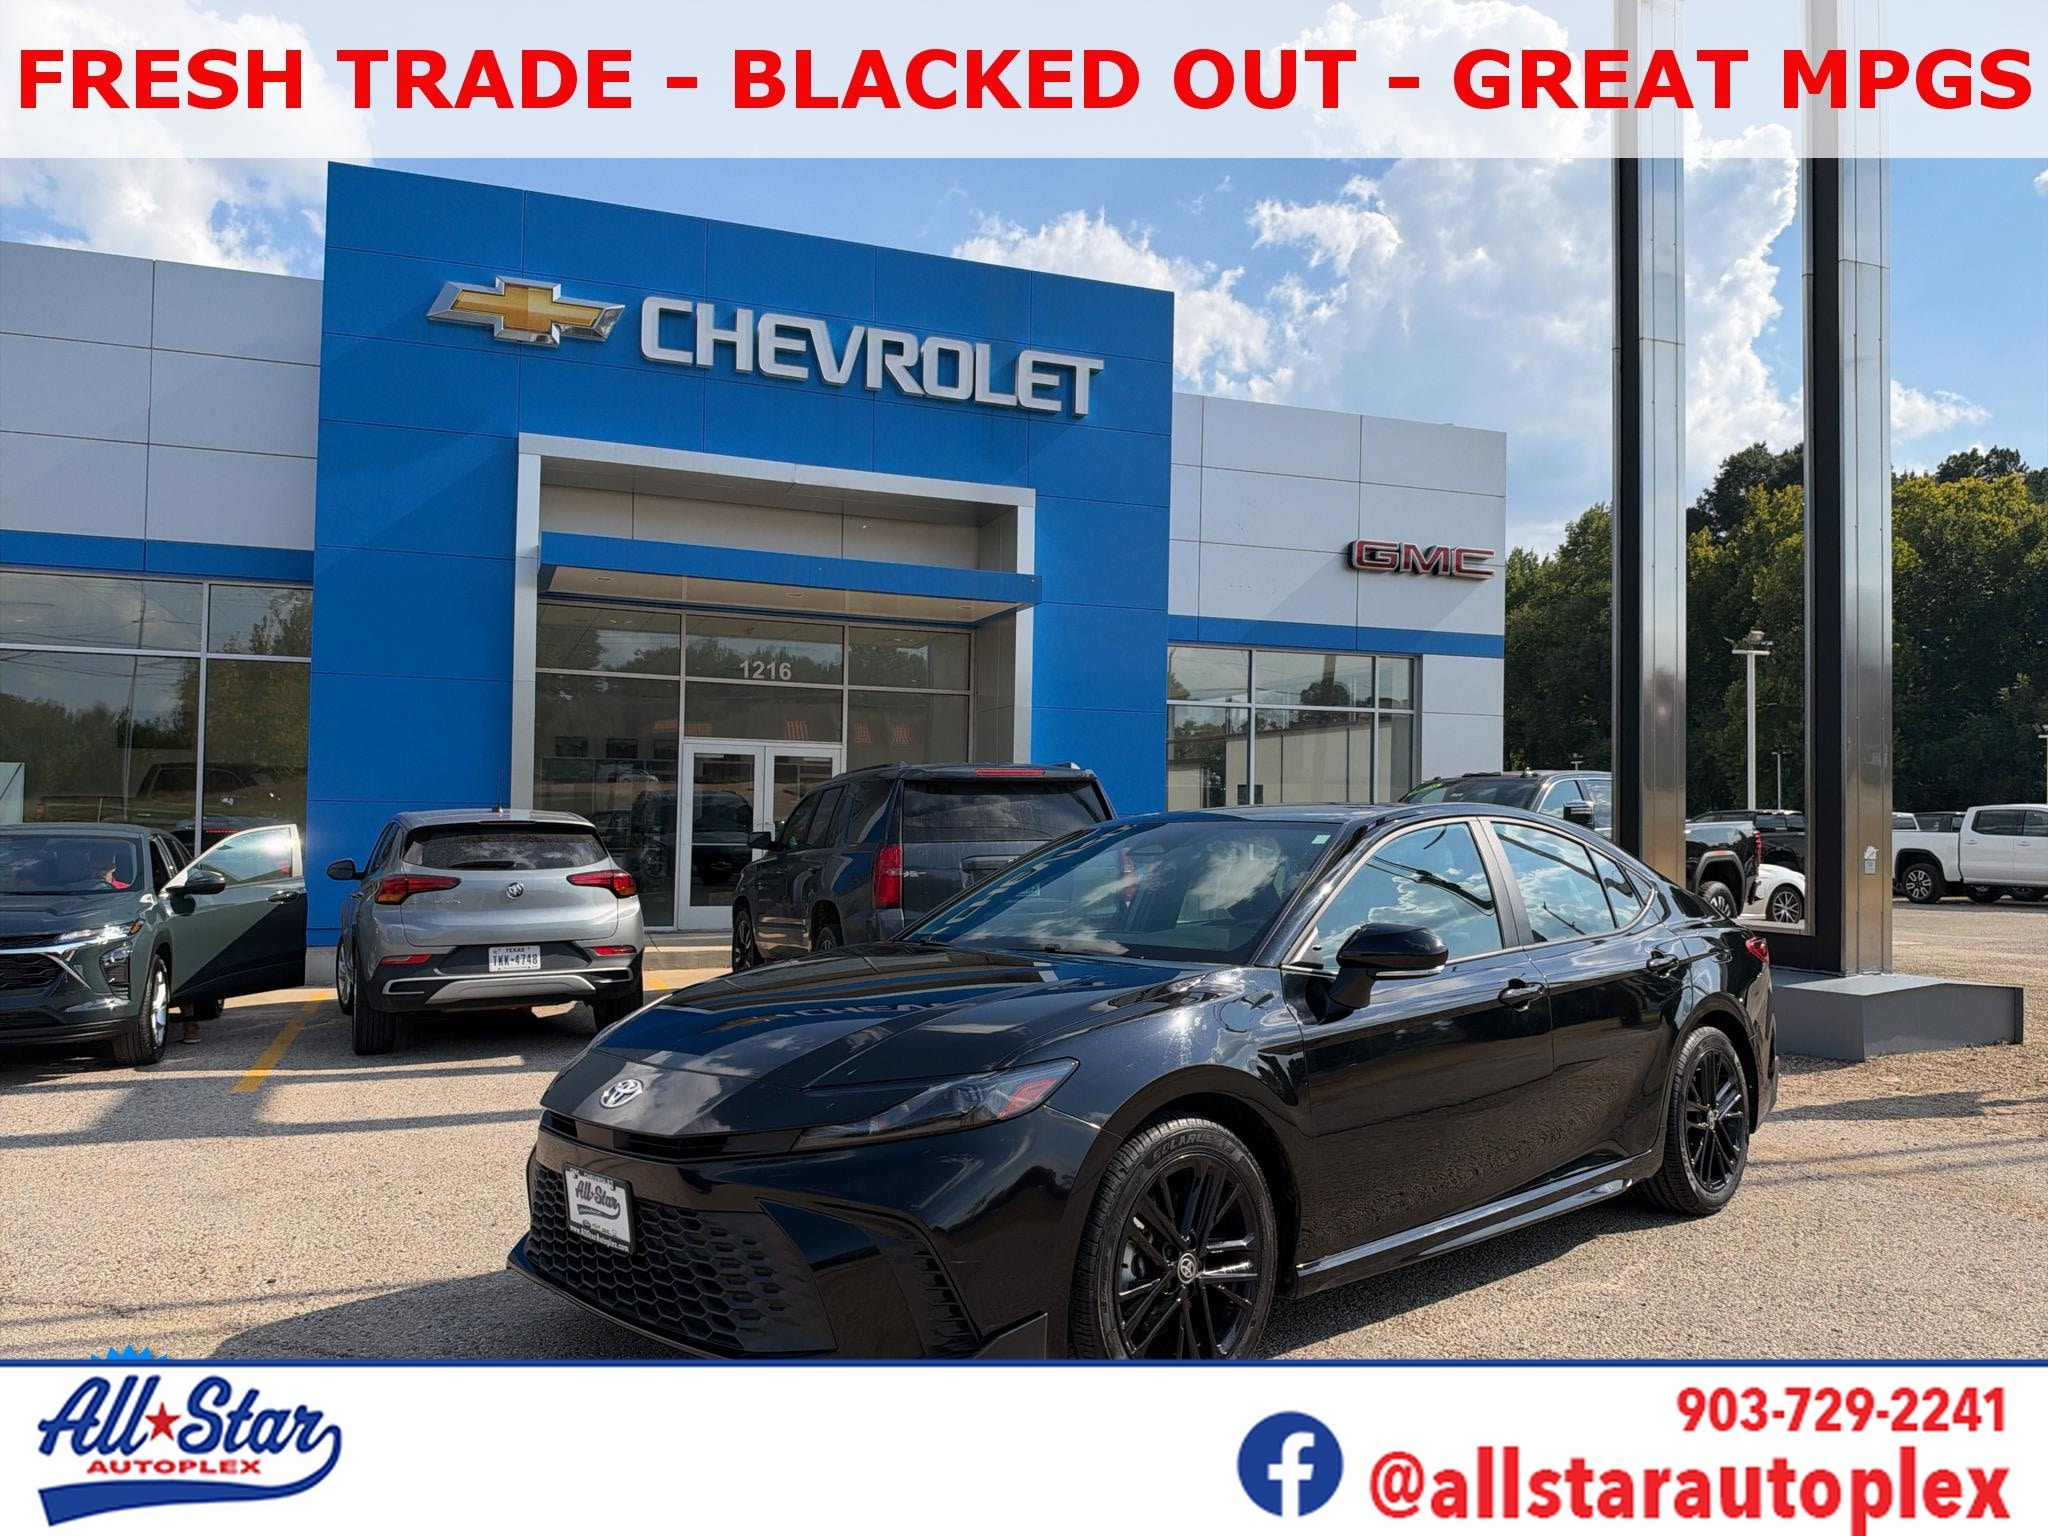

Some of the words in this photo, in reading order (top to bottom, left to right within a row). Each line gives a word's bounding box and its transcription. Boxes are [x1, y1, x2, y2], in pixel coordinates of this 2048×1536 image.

[640, 296, 1105, 416] CHEVROLET
[1350, 538, 1495, 579] GMC
[739, 659, 792, 680] 1216
